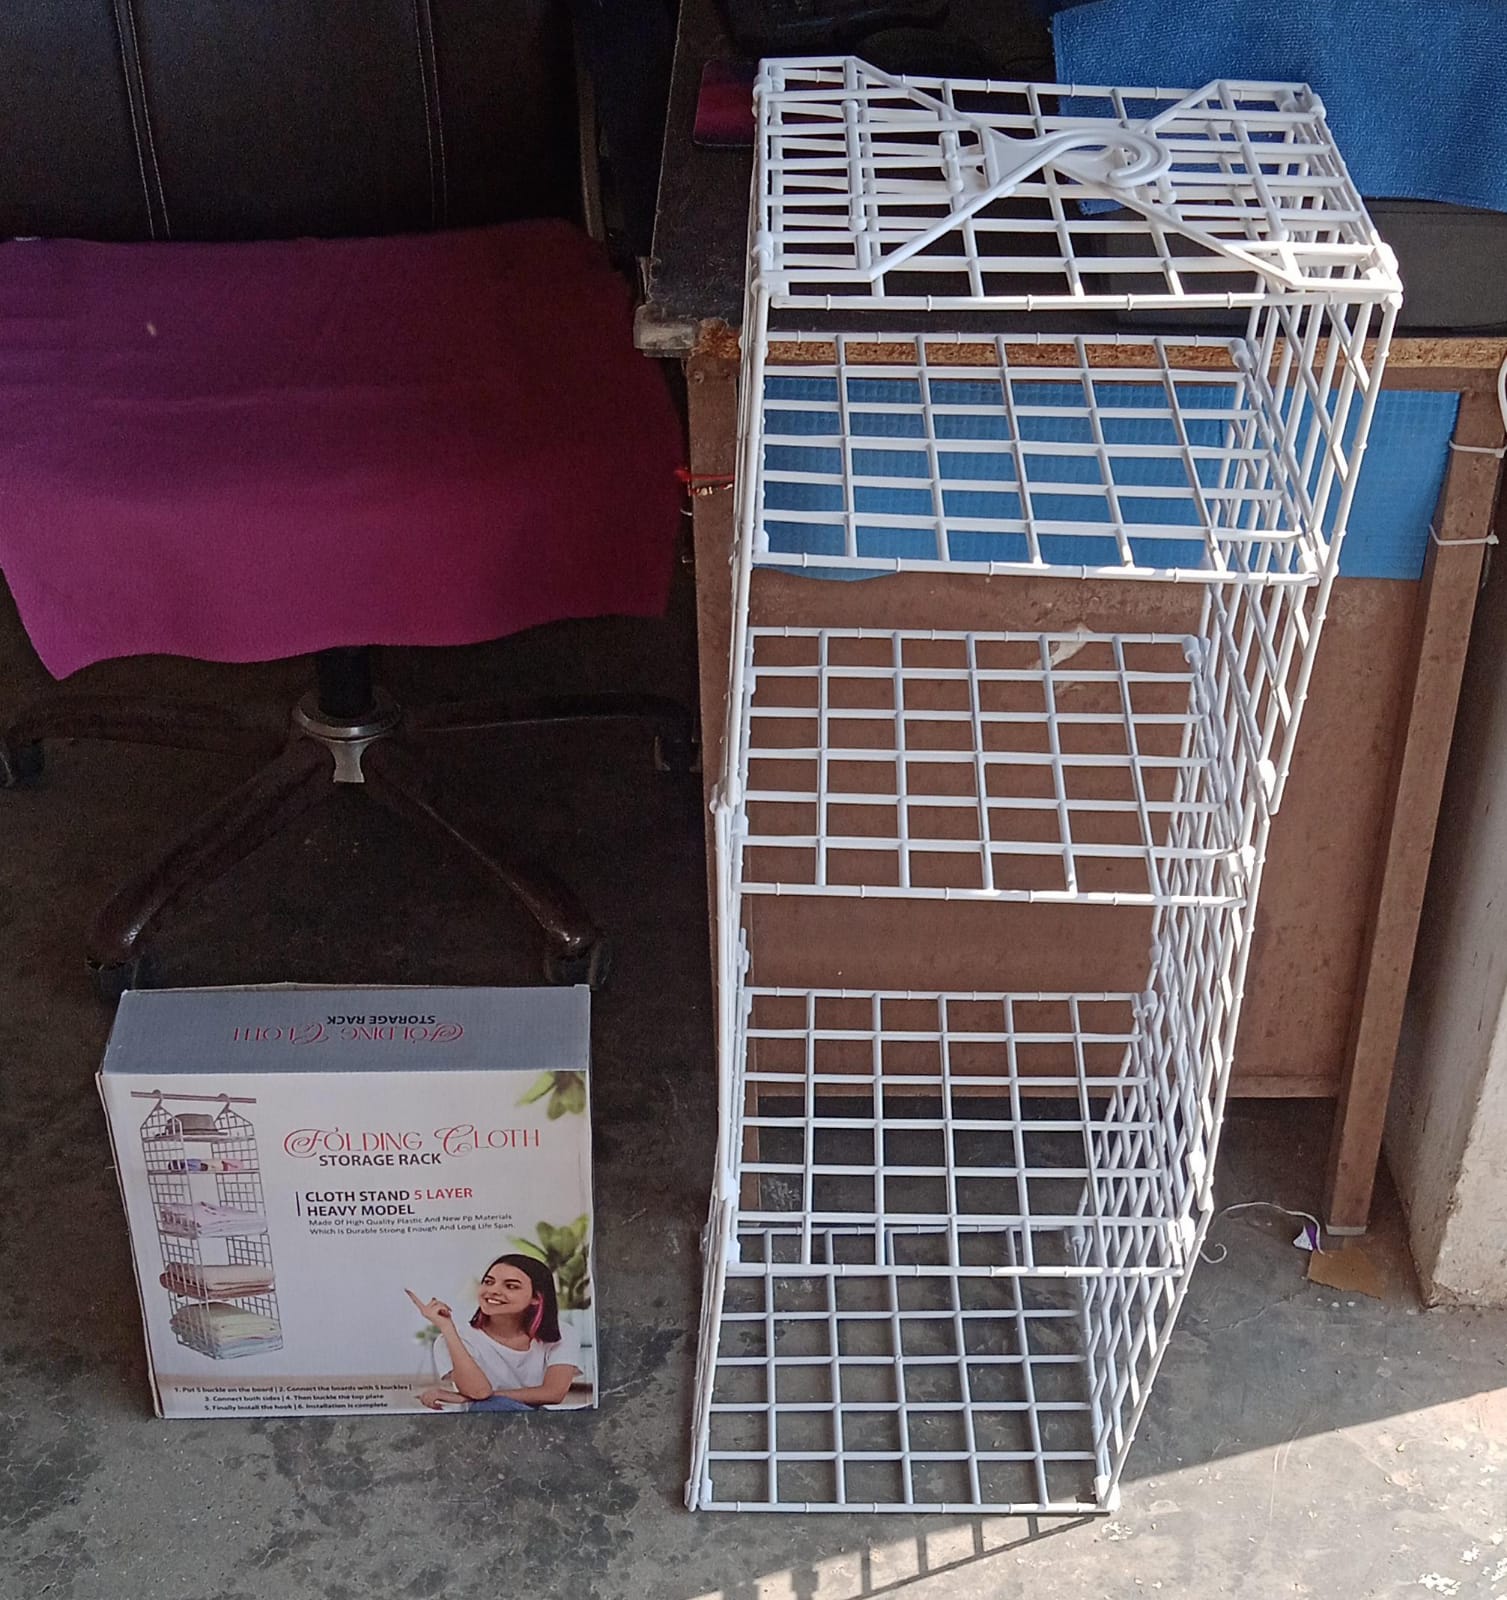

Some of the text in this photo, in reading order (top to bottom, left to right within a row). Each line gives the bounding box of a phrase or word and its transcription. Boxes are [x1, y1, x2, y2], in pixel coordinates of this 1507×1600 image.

[327, 1015, 436, 1025] STORAGE RACK
[233, 1022, 464, 1045] FOLDING CLOTH
[283, 1124, 540, 1158] FOLDING CLOTH
[319, 1153, 442, 1167] STORAGE RACK
[305, 1187, 473, 1202] CLOTH STAND 5 LAYER
[307, 1204, 415, 1216] HEAVY MODEL
[366, 1218, 395, 1226] Quality
[462, 1215, 473, 1223] Pp
[474, 1213, 512, 1221] Materials
[457, 1223, 476, 1231] Long
[478, 1222, 492, 1230] Life
